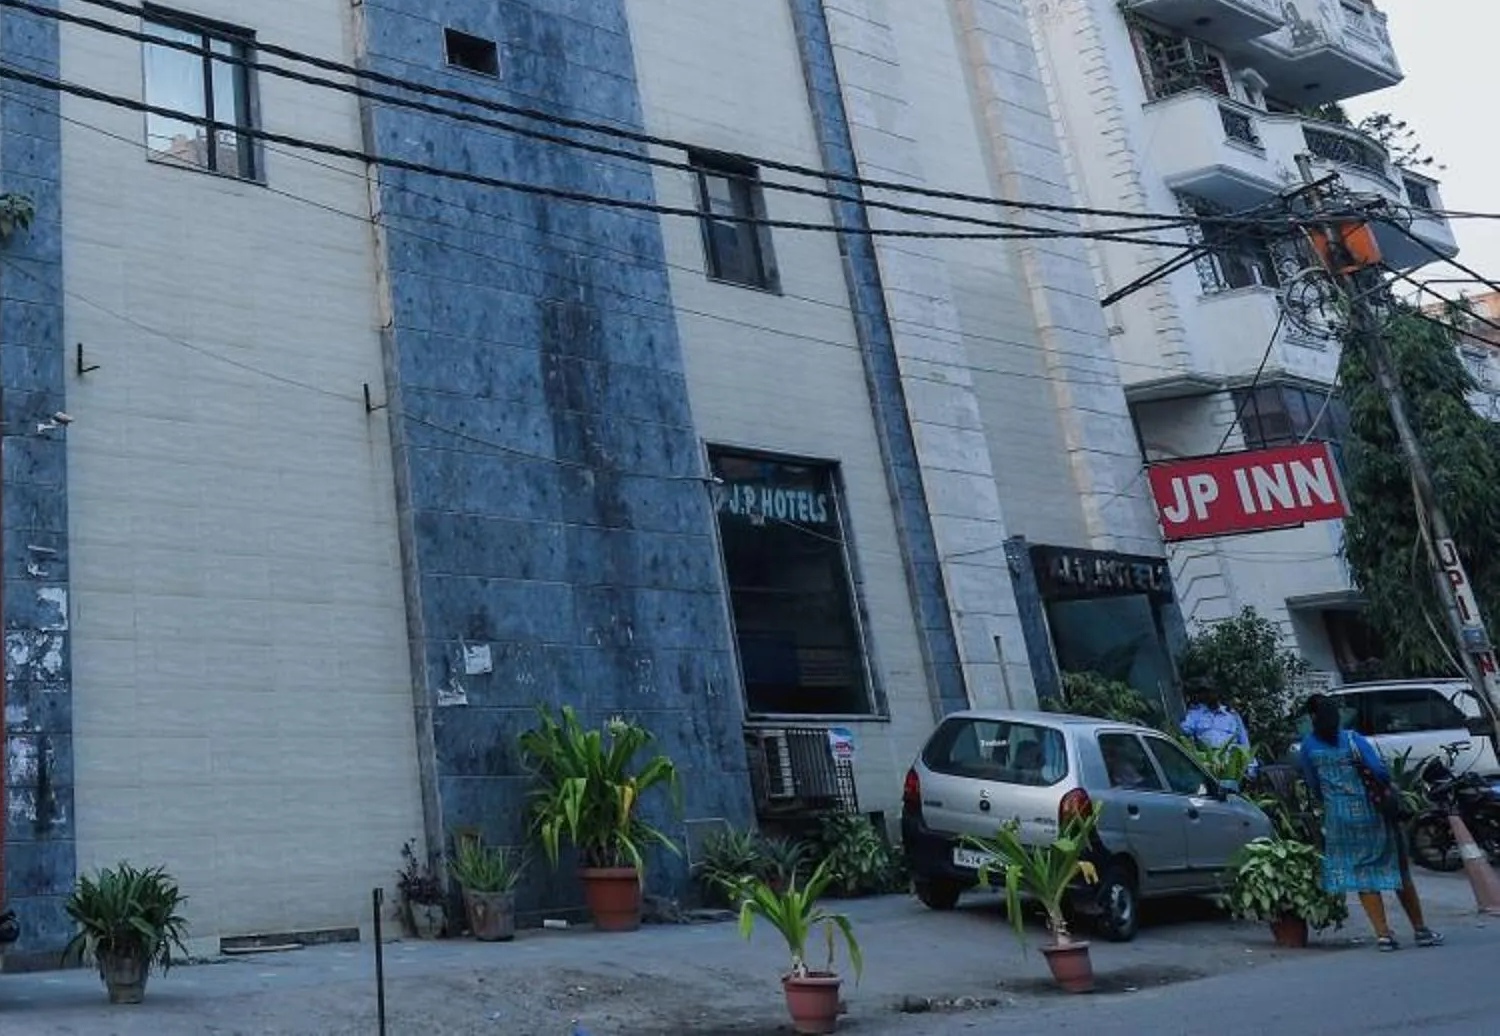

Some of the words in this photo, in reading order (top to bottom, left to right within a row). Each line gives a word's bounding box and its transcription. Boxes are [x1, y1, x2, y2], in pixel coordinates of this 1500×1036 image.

[762, 488, 828, 523] HOTELS
[1163, 474, 1219, 524] JP
[1233, 457, 1336, 515] INN
